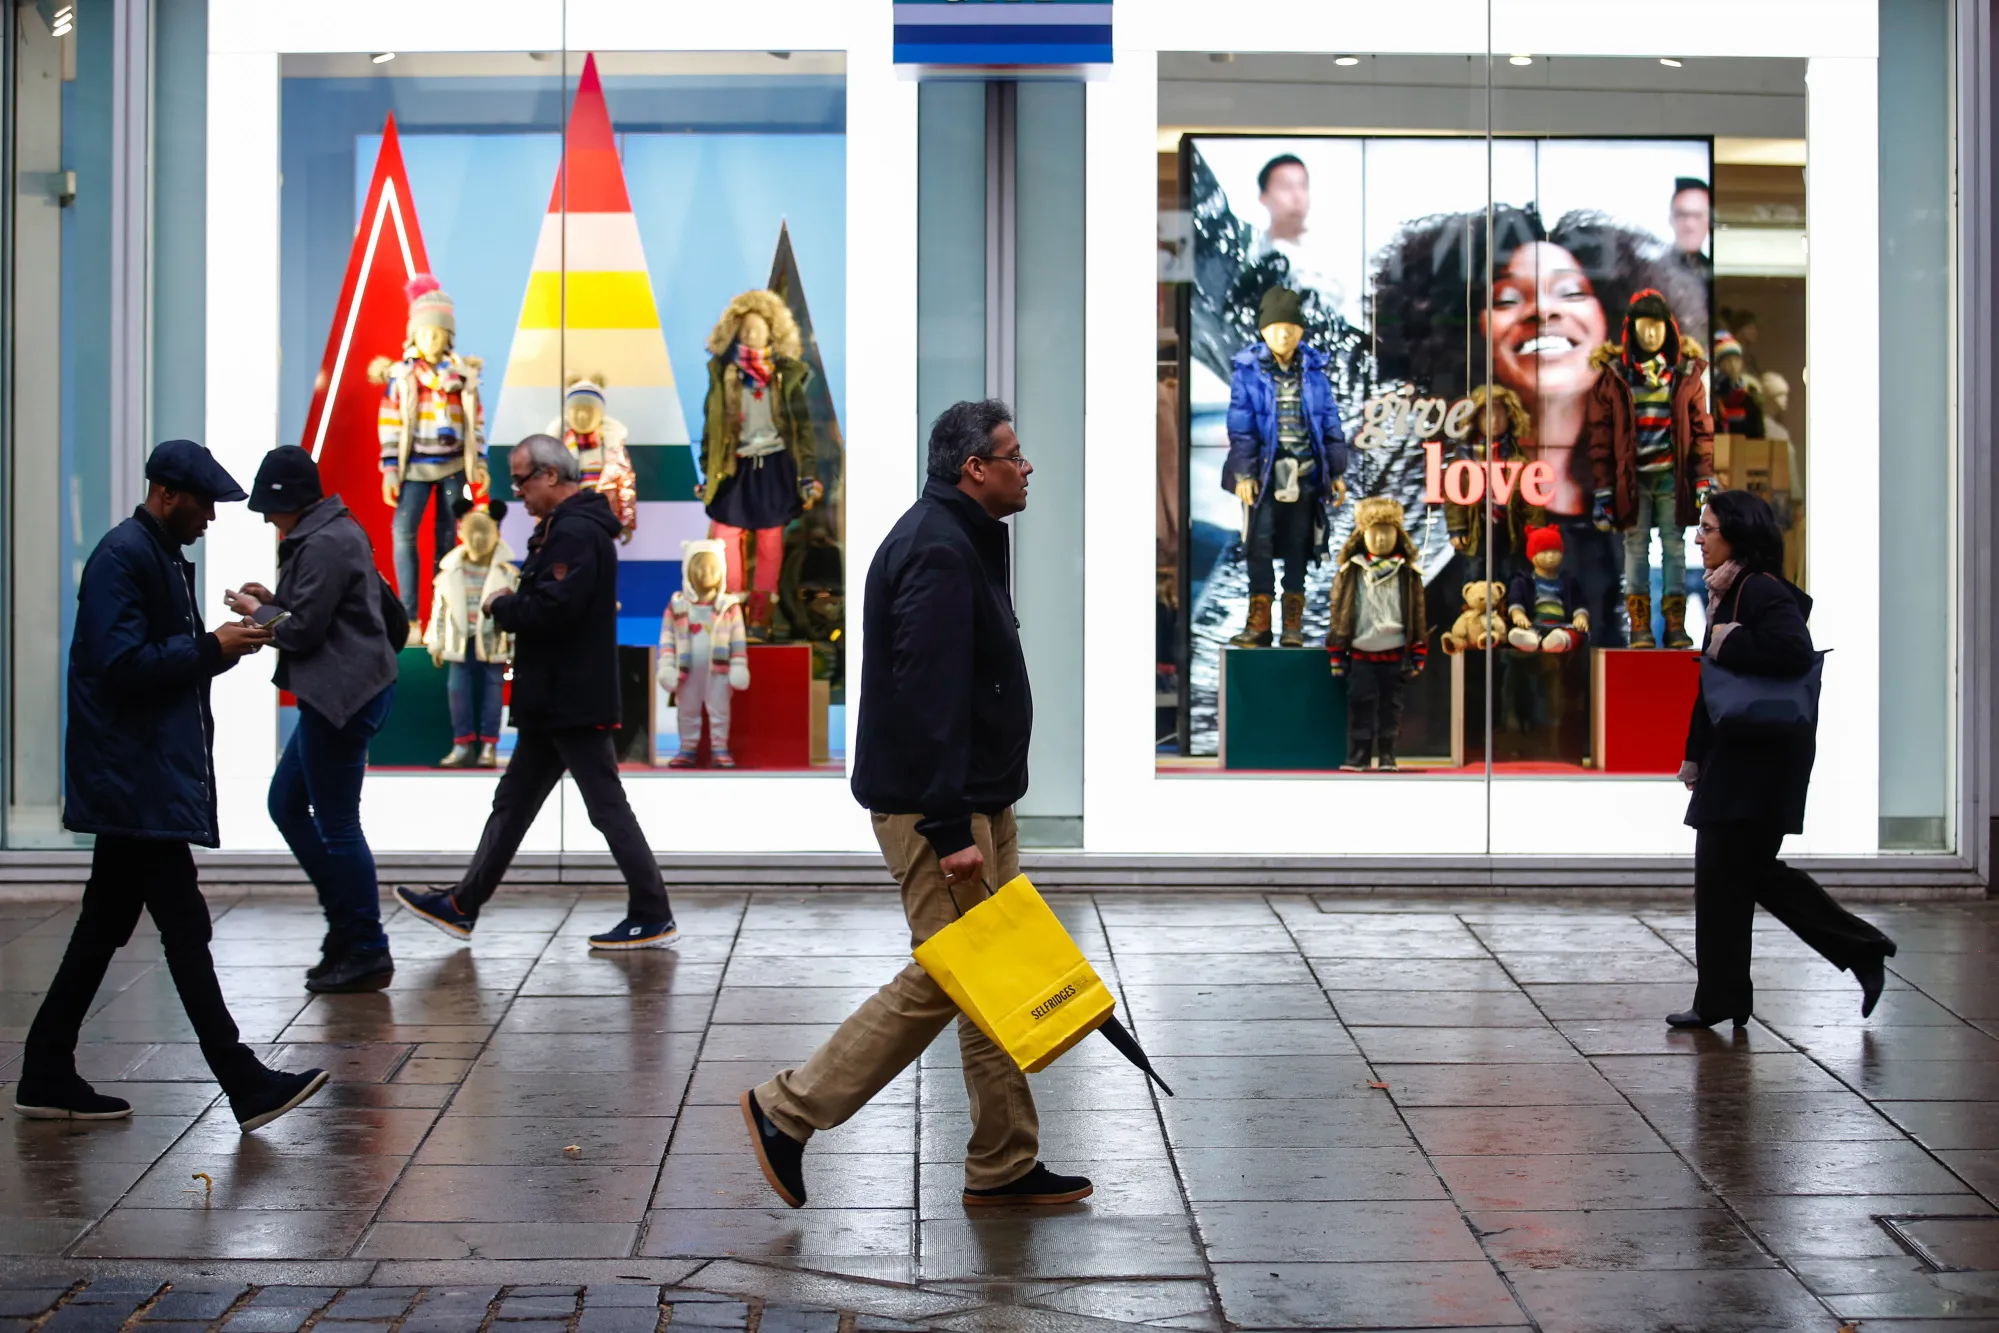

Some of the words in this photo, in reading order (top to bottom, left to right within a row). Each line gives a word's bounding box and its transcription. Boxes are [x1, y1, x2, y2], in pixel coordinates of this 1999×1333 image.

[1354, 384, 1475, 449] give
[1422, 441, 1557, 506] love
[1031, 984, 1077, 1020] SELFRIDGES
